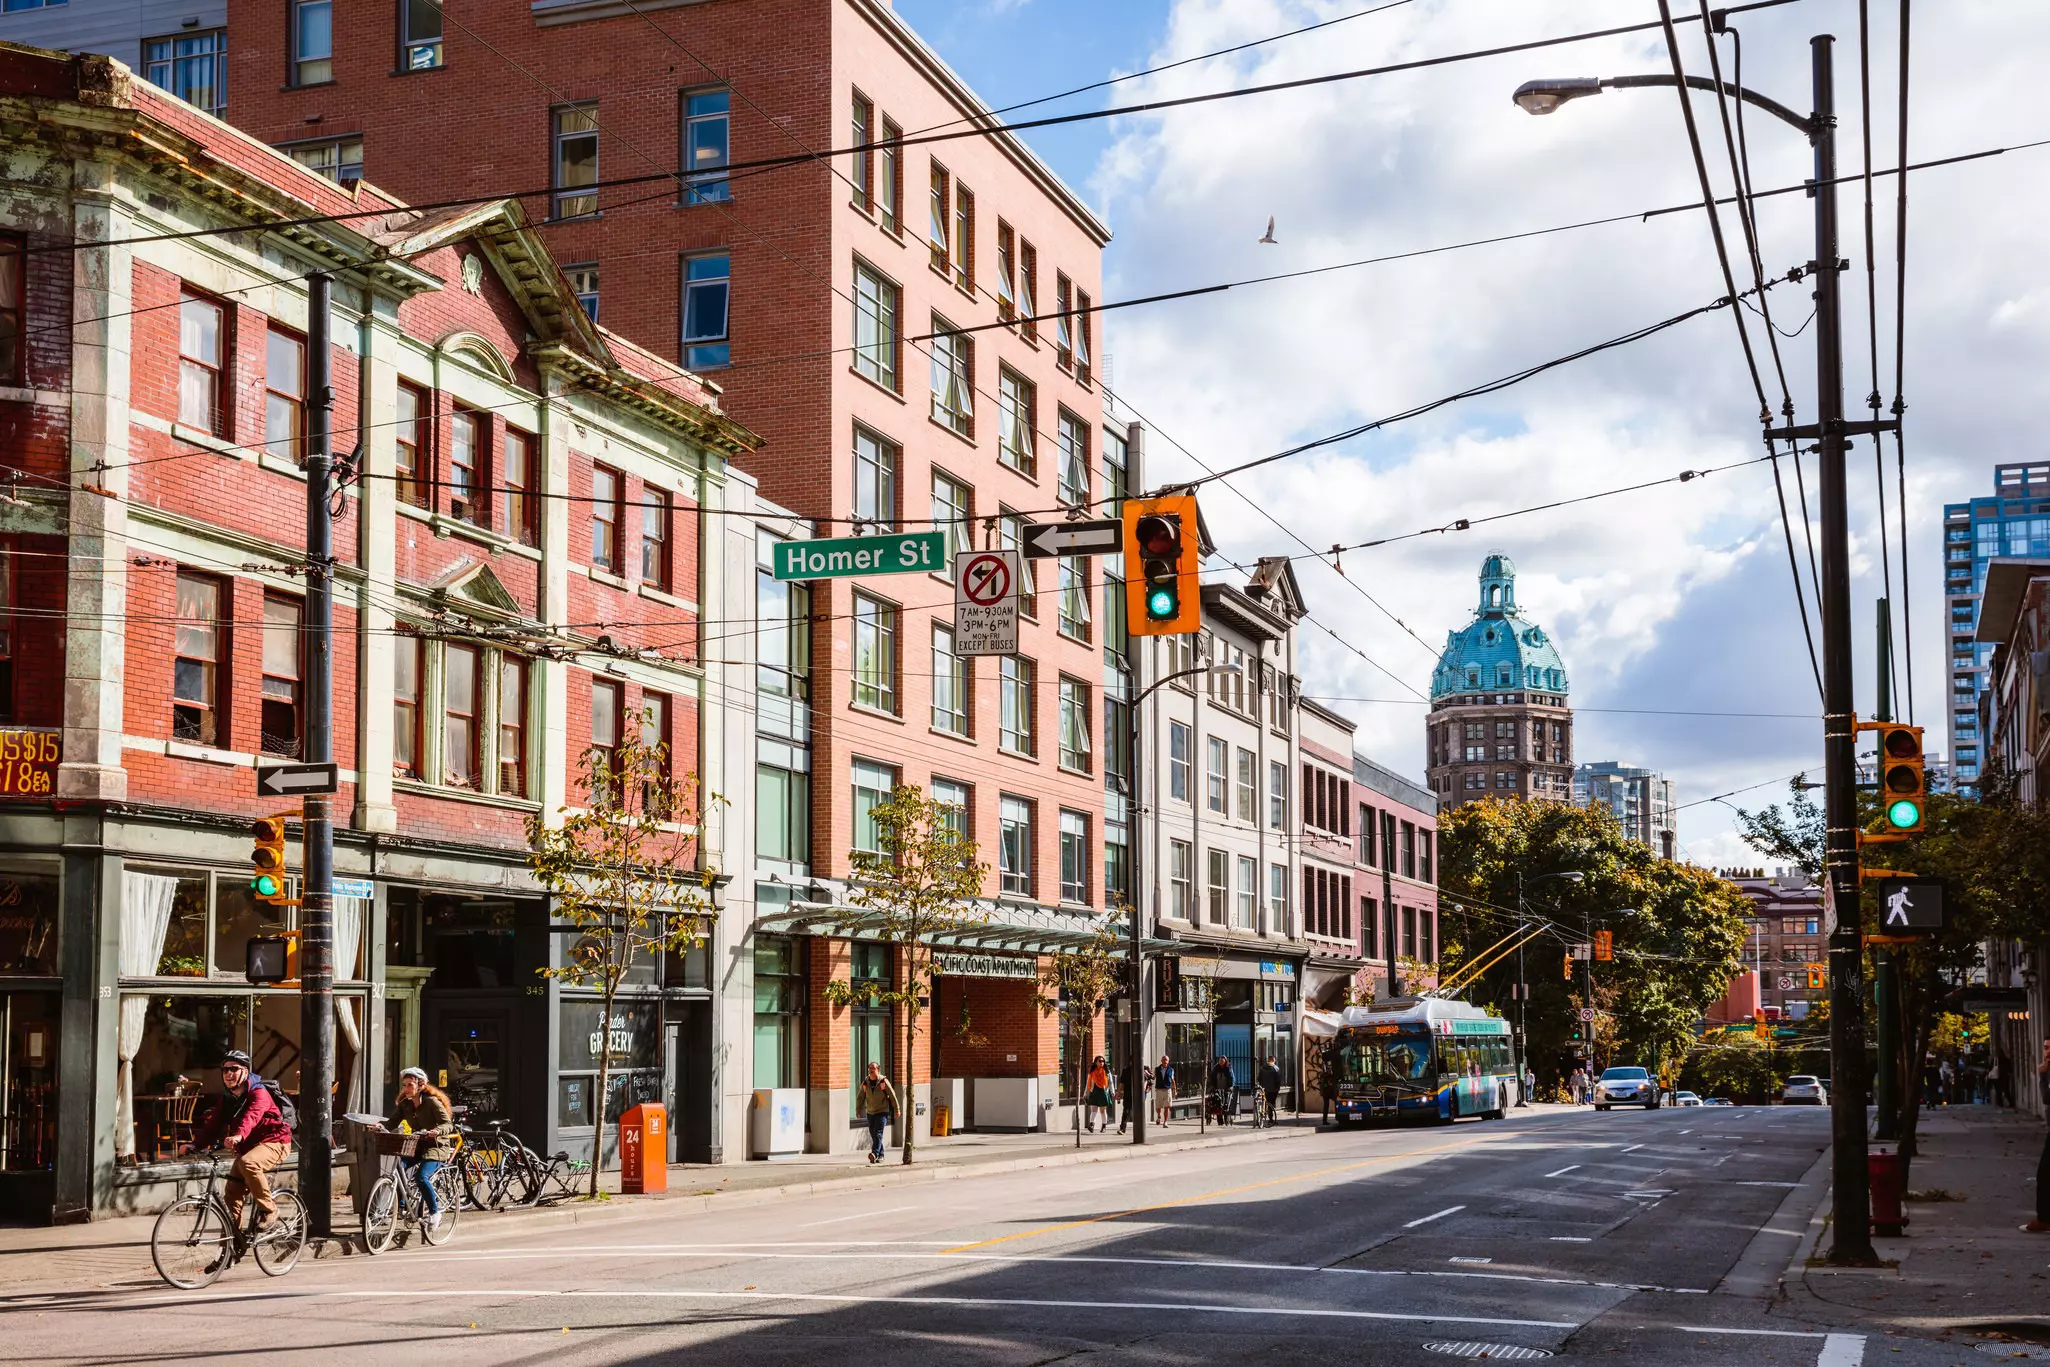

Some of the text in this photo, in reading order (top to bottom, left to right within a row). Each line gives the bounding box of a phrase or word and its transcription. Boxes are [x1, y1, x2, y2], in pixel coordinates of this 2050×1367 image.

[787, 540, 931, 573] Homer St
[963, 620, 1010, 632] 3PM-6PM
[959, 639, 1014, 651] EXCEPT BUSES
[934, 955, 1036, 976] PACIFIC COAST APARTMENTS
[1163, 959, 1172, 1002] RUSH
[526, 985, 545, 996] 345
[1349, 1027, 1355, 1037] 7
[589, 1031, 633, 1053] GRCERY
[626, 1129, 640, 1144] 24
